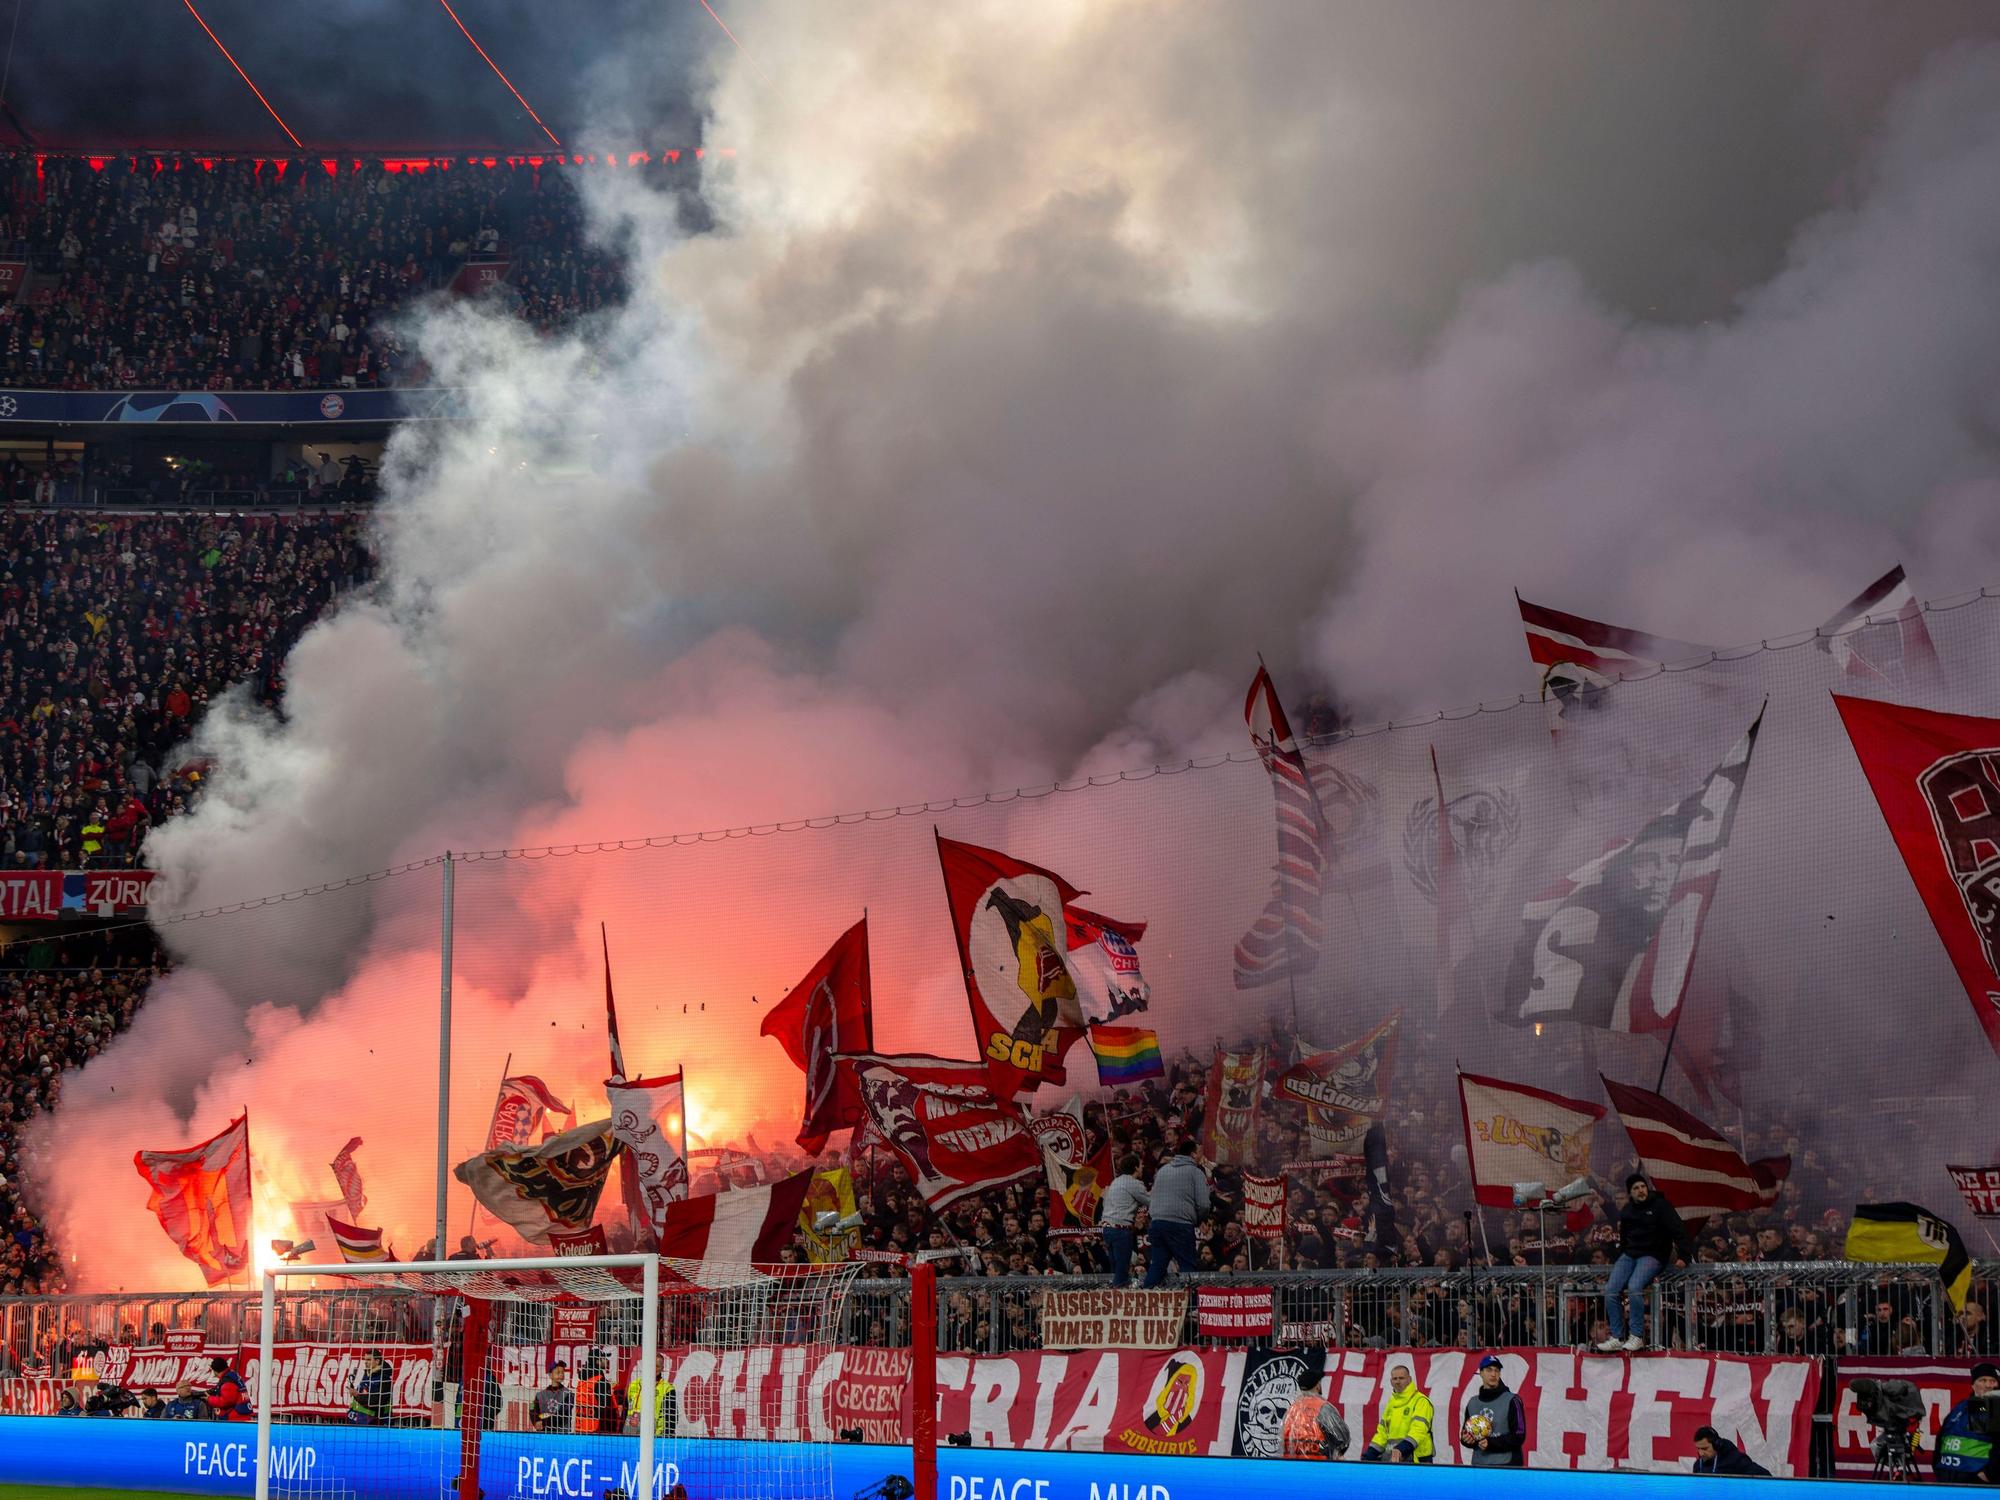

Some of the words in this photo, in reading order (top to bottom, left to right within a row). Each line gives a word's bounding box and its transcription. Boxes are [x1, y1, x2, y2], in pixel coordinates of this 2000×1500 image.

[1044, 1289, 1186, 1317] AUSGESPERRTE
[1043, 1319, 1104, 1345] IMMER
[1108, 1318, 1137, 1344] BEI
[1143, 1319, 1178, 1344] UNS
[843, 1348, 909, 1377] ULTRAS
[836, 1381, 904, 1412] GEGEN
[1269, 1383, 1293, 1395] 1987
[1120, 1428, 1197, 1454] SÜDKURVE
[185, 1441, 248, 1478] PEACE
[269, 1445, 316, 1481] МИР
[518, 1456, 593, 1497] PEACE
